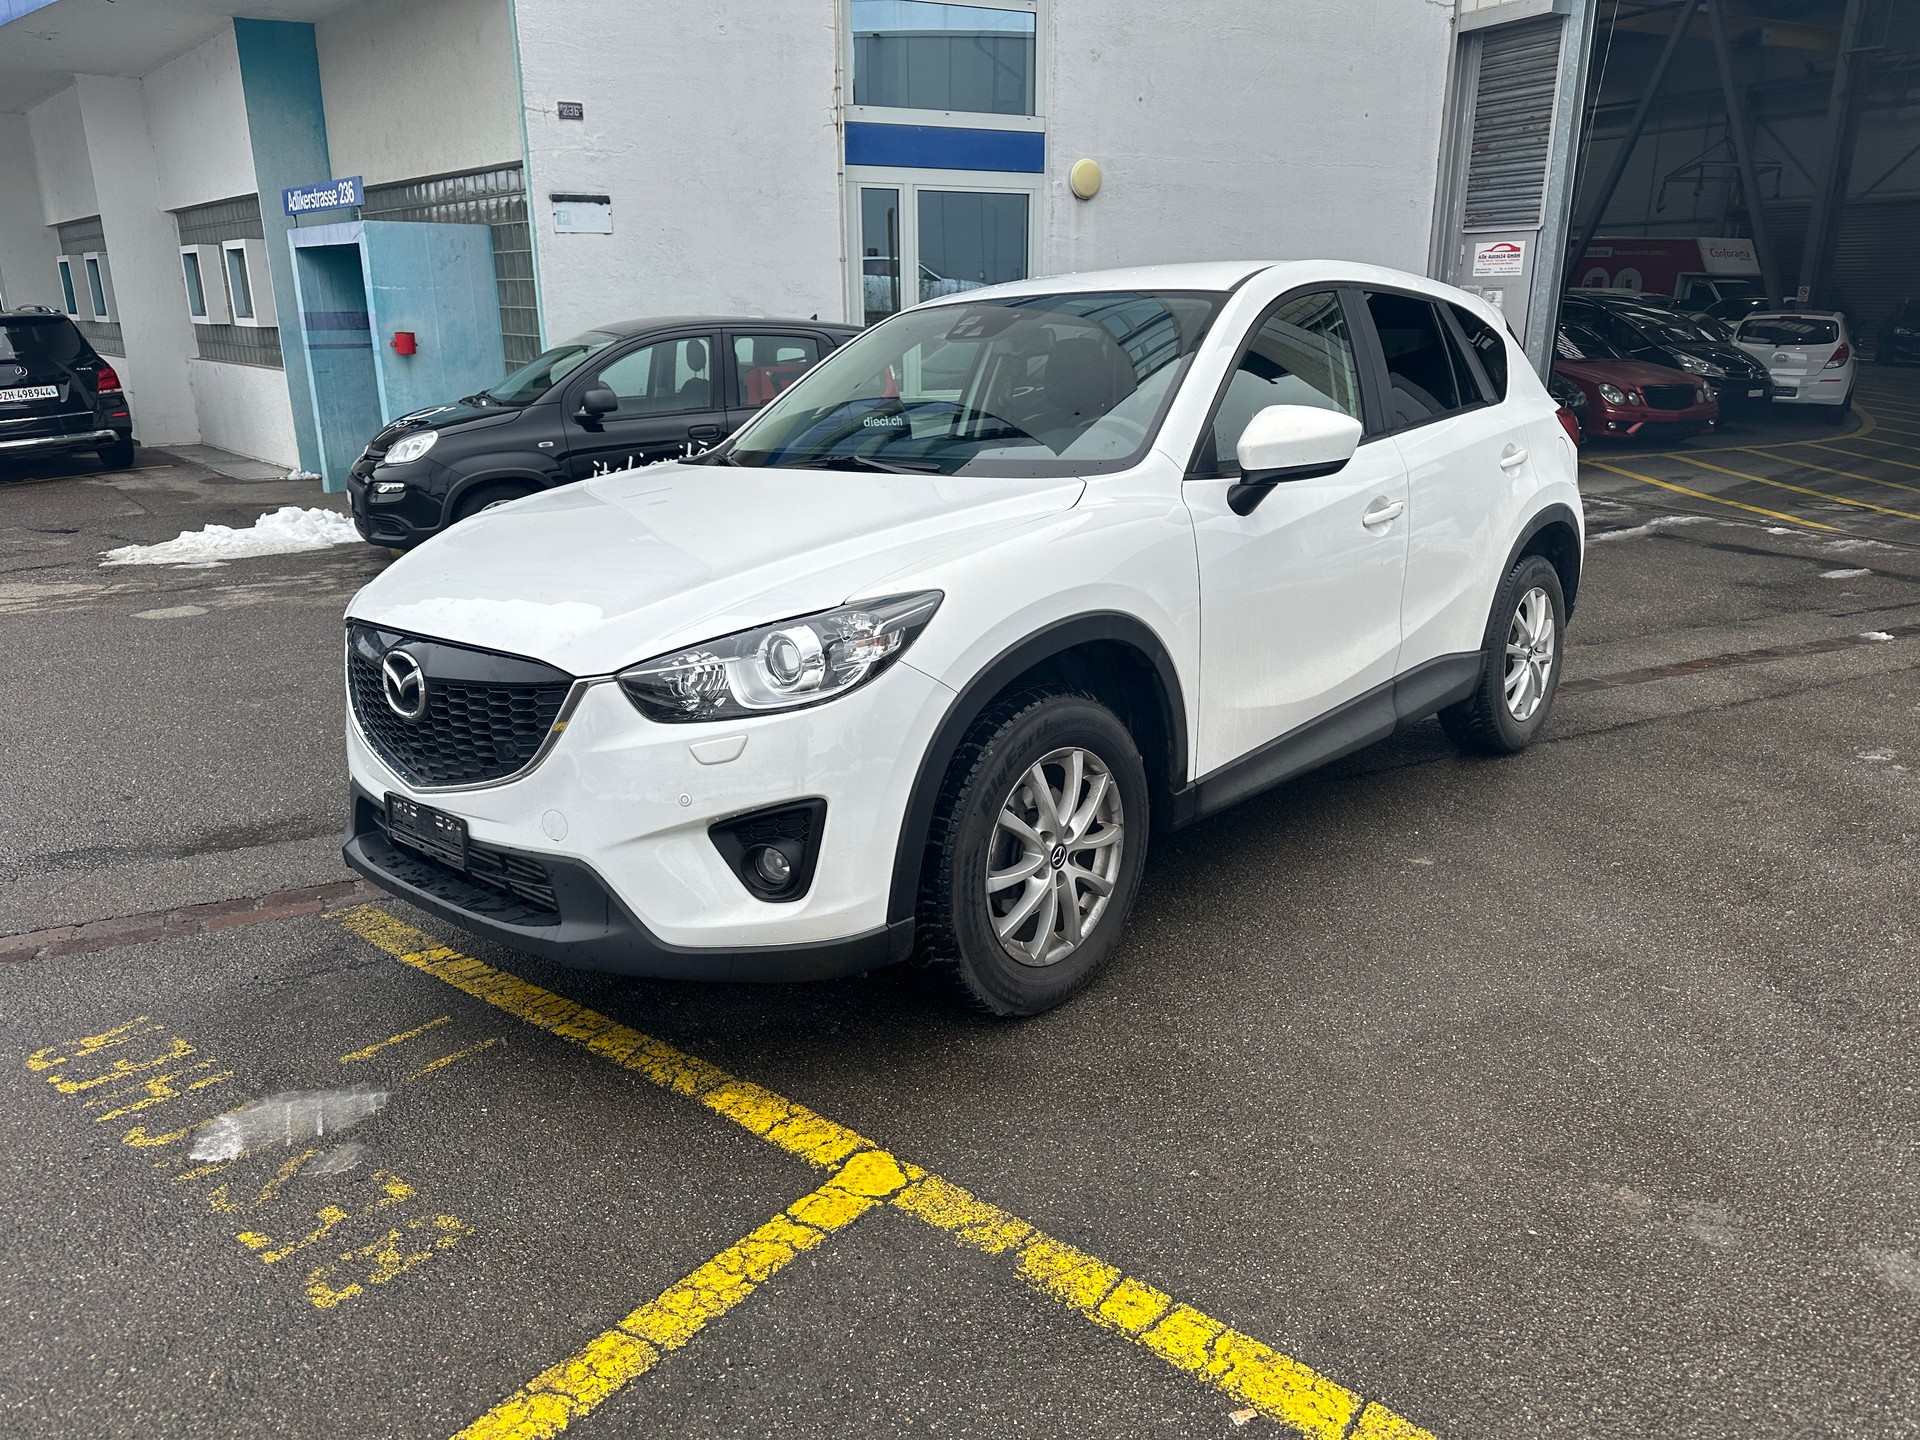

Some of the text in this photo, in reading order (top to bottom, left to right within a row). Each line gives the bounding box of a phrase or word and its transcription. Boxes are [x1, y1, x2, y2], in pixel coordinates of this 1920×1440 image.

[562, 105, 579, 116] 236
[287, 180, 355, 211] Adlikerstrasse 236
[1709, 247, 1751, 258] Conforama
[863, 415, 903, 427] dieci.ch
